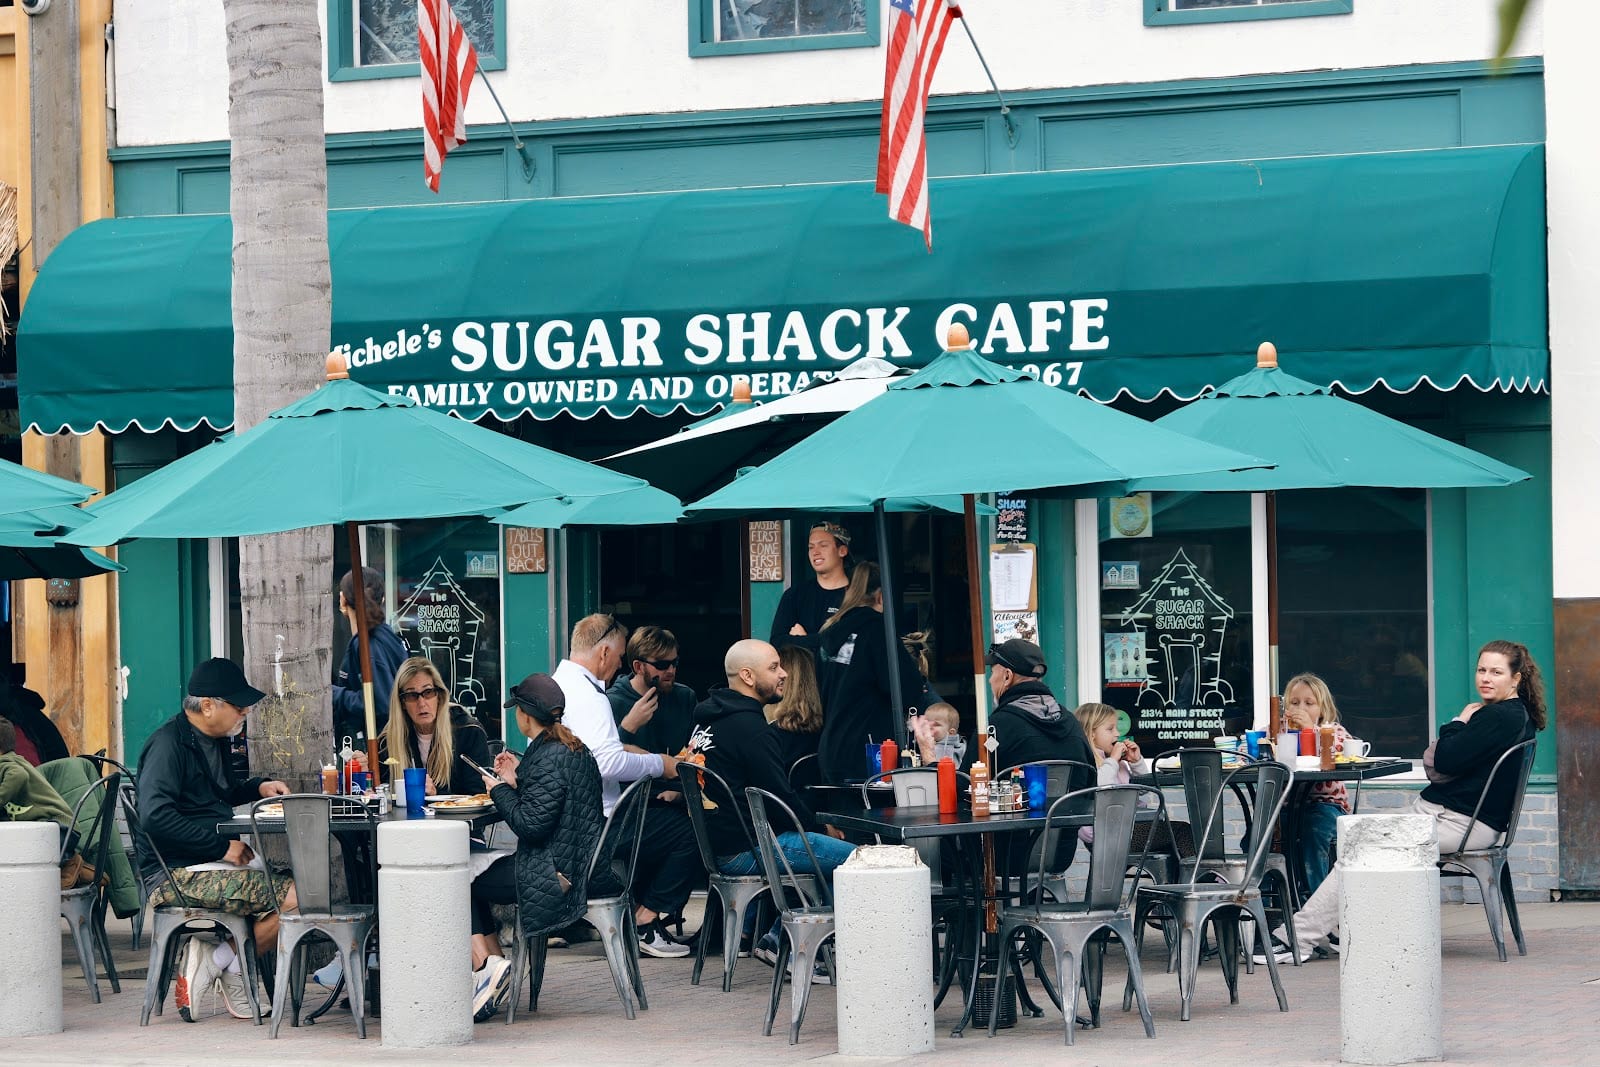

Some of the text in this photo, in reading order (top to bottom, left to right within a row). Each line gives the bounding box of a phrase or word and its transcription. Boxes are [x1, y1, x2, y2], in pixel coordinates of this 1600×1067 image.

[334, 299, 1110, 372] ichele's SUGAR SHACK CAFE
[388, 361, 1083, 407] FAMILY OWNED AND OERA 67
[997, 499, 1026, 509] SHACK
[749, 521, 780, 530] INSIDE
[508, 527, 543, 544] TABLES
[751, 531, 780, 542] FIRST
[511, 543, 539, 559] OUT
[750, 543, 780, 555] COME
[508, 557, 545, 572] BACK
[750, 555, 780, 568] FIRST
[750, 567, 781, 580] SERVE
[430, 592, 447, 602] The
[1170, 586, 1190, 597] The
[417, 604, 460, 618] SUGAR
[1155, 599, 1204, 614] SUGAR
[417, 619, 460, 632] SHACK
[1155, 615, 1205, 629] SHACK
[1165, 709, 1187, 718] MAIN
[1189, 708, 1225, 718] STREET
[1138, 720, 1225, 729] HUNTINGTON BEACH
[1157, 731, 1209, 739] CALIFORNIA
